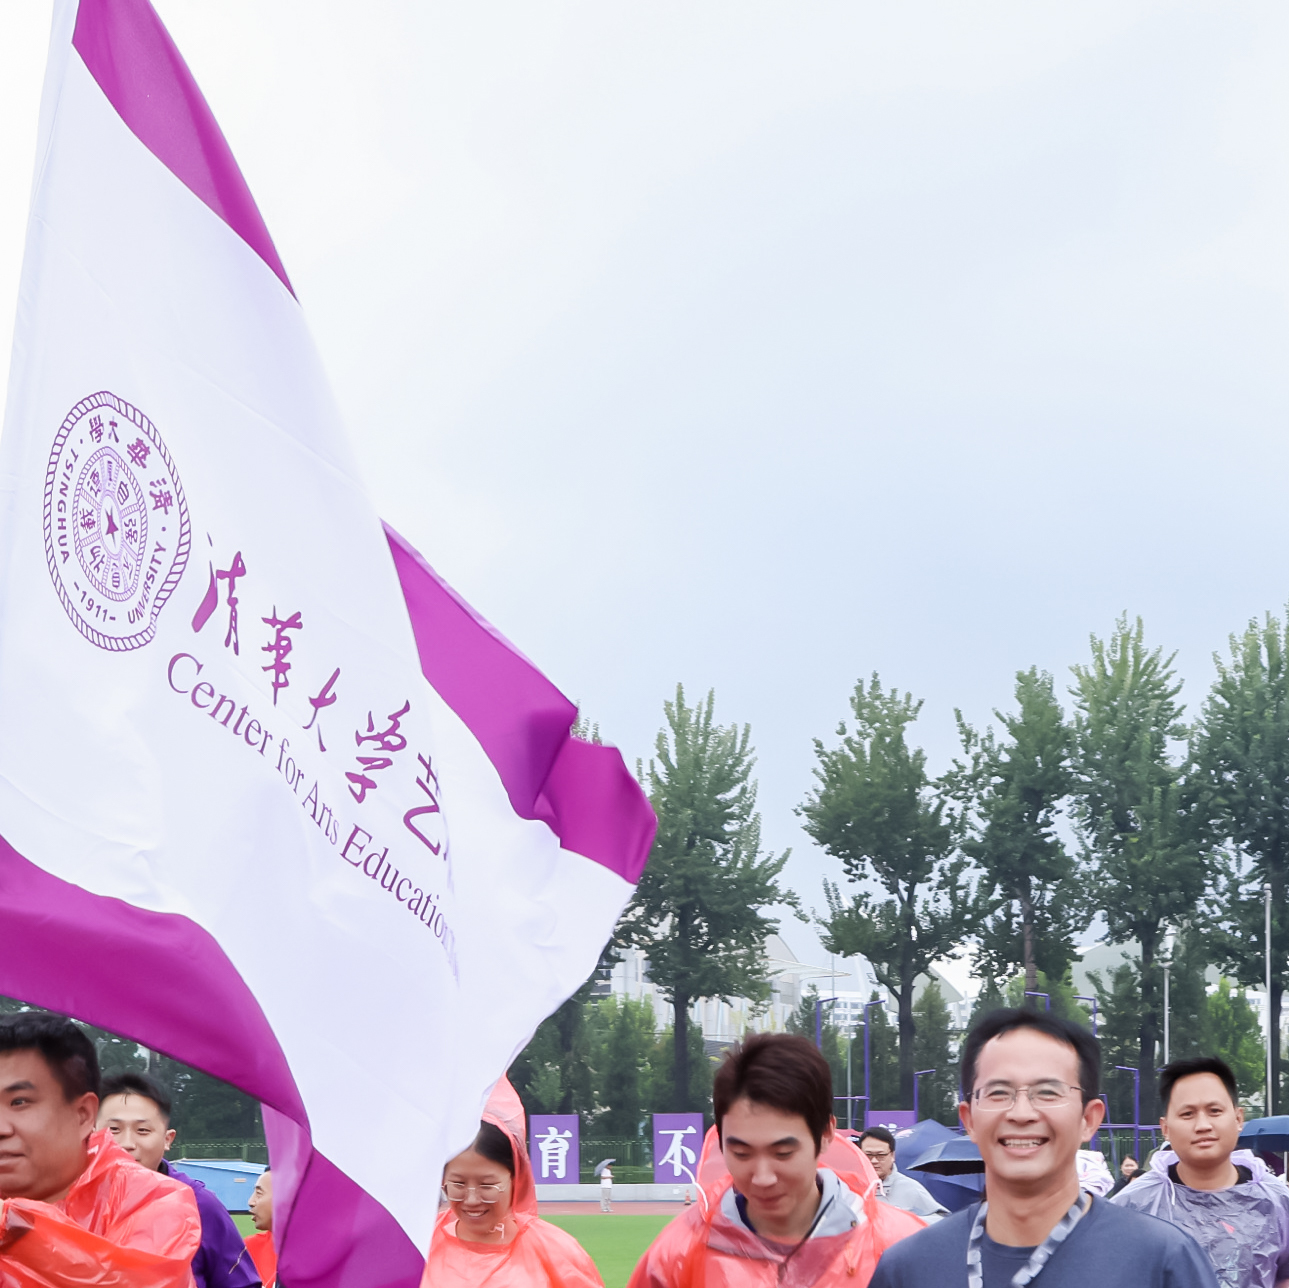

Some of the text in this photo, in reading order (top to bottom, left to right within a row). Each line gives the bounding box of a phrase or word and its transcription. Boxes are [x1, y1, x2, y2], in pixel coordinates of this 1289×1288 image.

[56, 448, 79, 564] TSINGHUA
[167, 652, 273, 756] Center
[276, 738, 305, 794] for
[301, 780, 340, 845] Arts
[534, 1125, 697, 1179] 育 不
